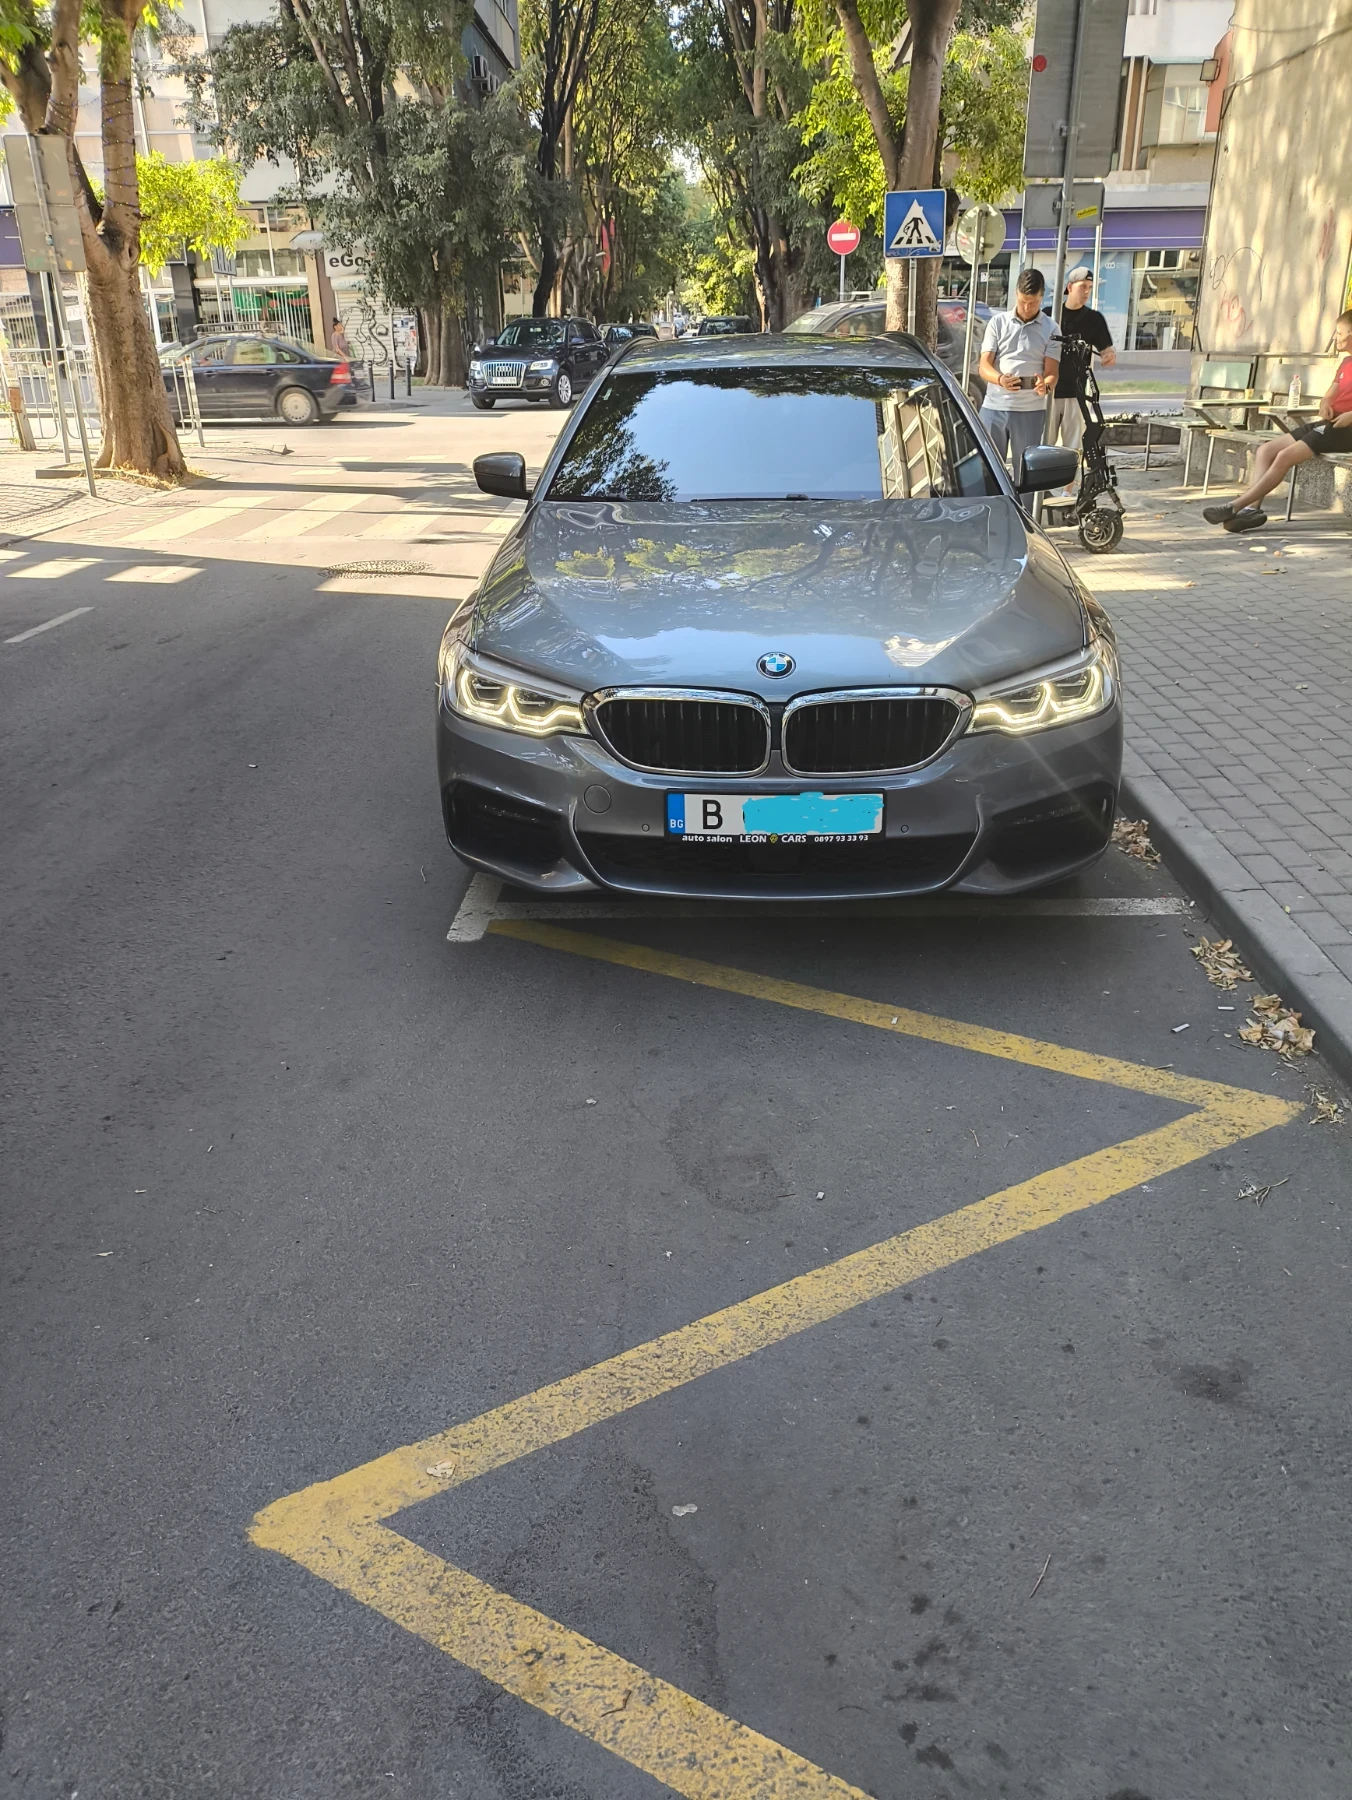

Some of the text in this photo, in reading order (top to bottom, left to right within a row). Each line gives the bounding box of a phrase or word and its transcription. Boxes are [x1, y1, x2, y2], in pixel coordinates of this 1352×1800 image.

[702, 799, 723, 830] B
[670, 818, 684, 829] BG
[682, 834, 704, 842] auto
[706, 835, 733, 843] salon
[739, 834, 767, 843] LEON
[781, 834, 807, 843] CARS
